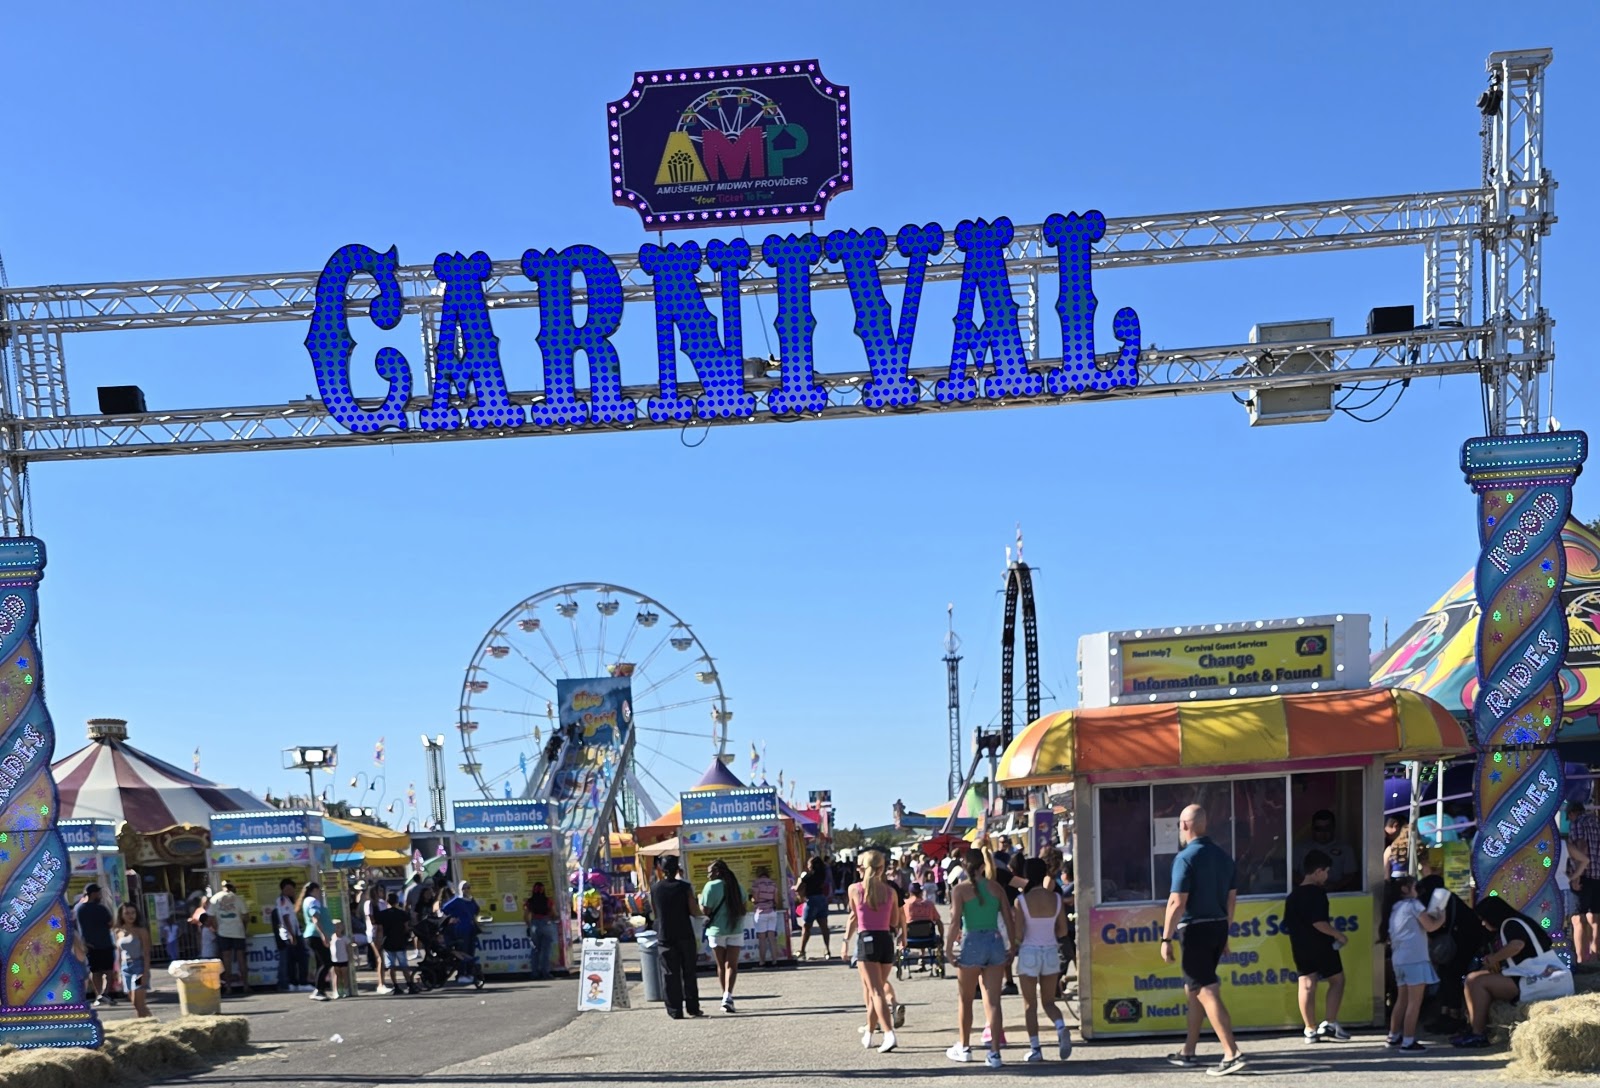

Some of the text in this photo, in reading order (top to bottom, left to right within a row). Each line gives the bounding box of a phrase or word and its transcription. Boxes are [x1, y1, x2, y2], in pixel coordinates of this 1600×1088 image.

[654, 122, 809, 185] AMP
[656, 176, 809, 195] AMUSEMENT MIDWAY PROVIDERS
[304, 209, 1140, 434] CARNIVAL
[1487, 492, 1559, 574] FOOD
[0, 594, 26, 649] OD
[1184, 639, 1268, 653] Carnival Guest Services
[1198, 653, 1255, 669] Change
[1132, 664, 1323, 691] Information Lost & Found
[1485, 629, 1559, 719] RIDES
[0, 723, 46, 806] IDES
[481, 809, 543, 823] Armbands
[709, 797, 772, 815] Armbands
[1482, 769, 1558, 858] GAMES
[239, 819, 303, 836] Armbands
[1228, 916, 1261, 938] est
[1231, 969, 1264, 986] Lost
[1265, 967, 1278, 985] &
[1147, 1003, 1180, 1018] Need
